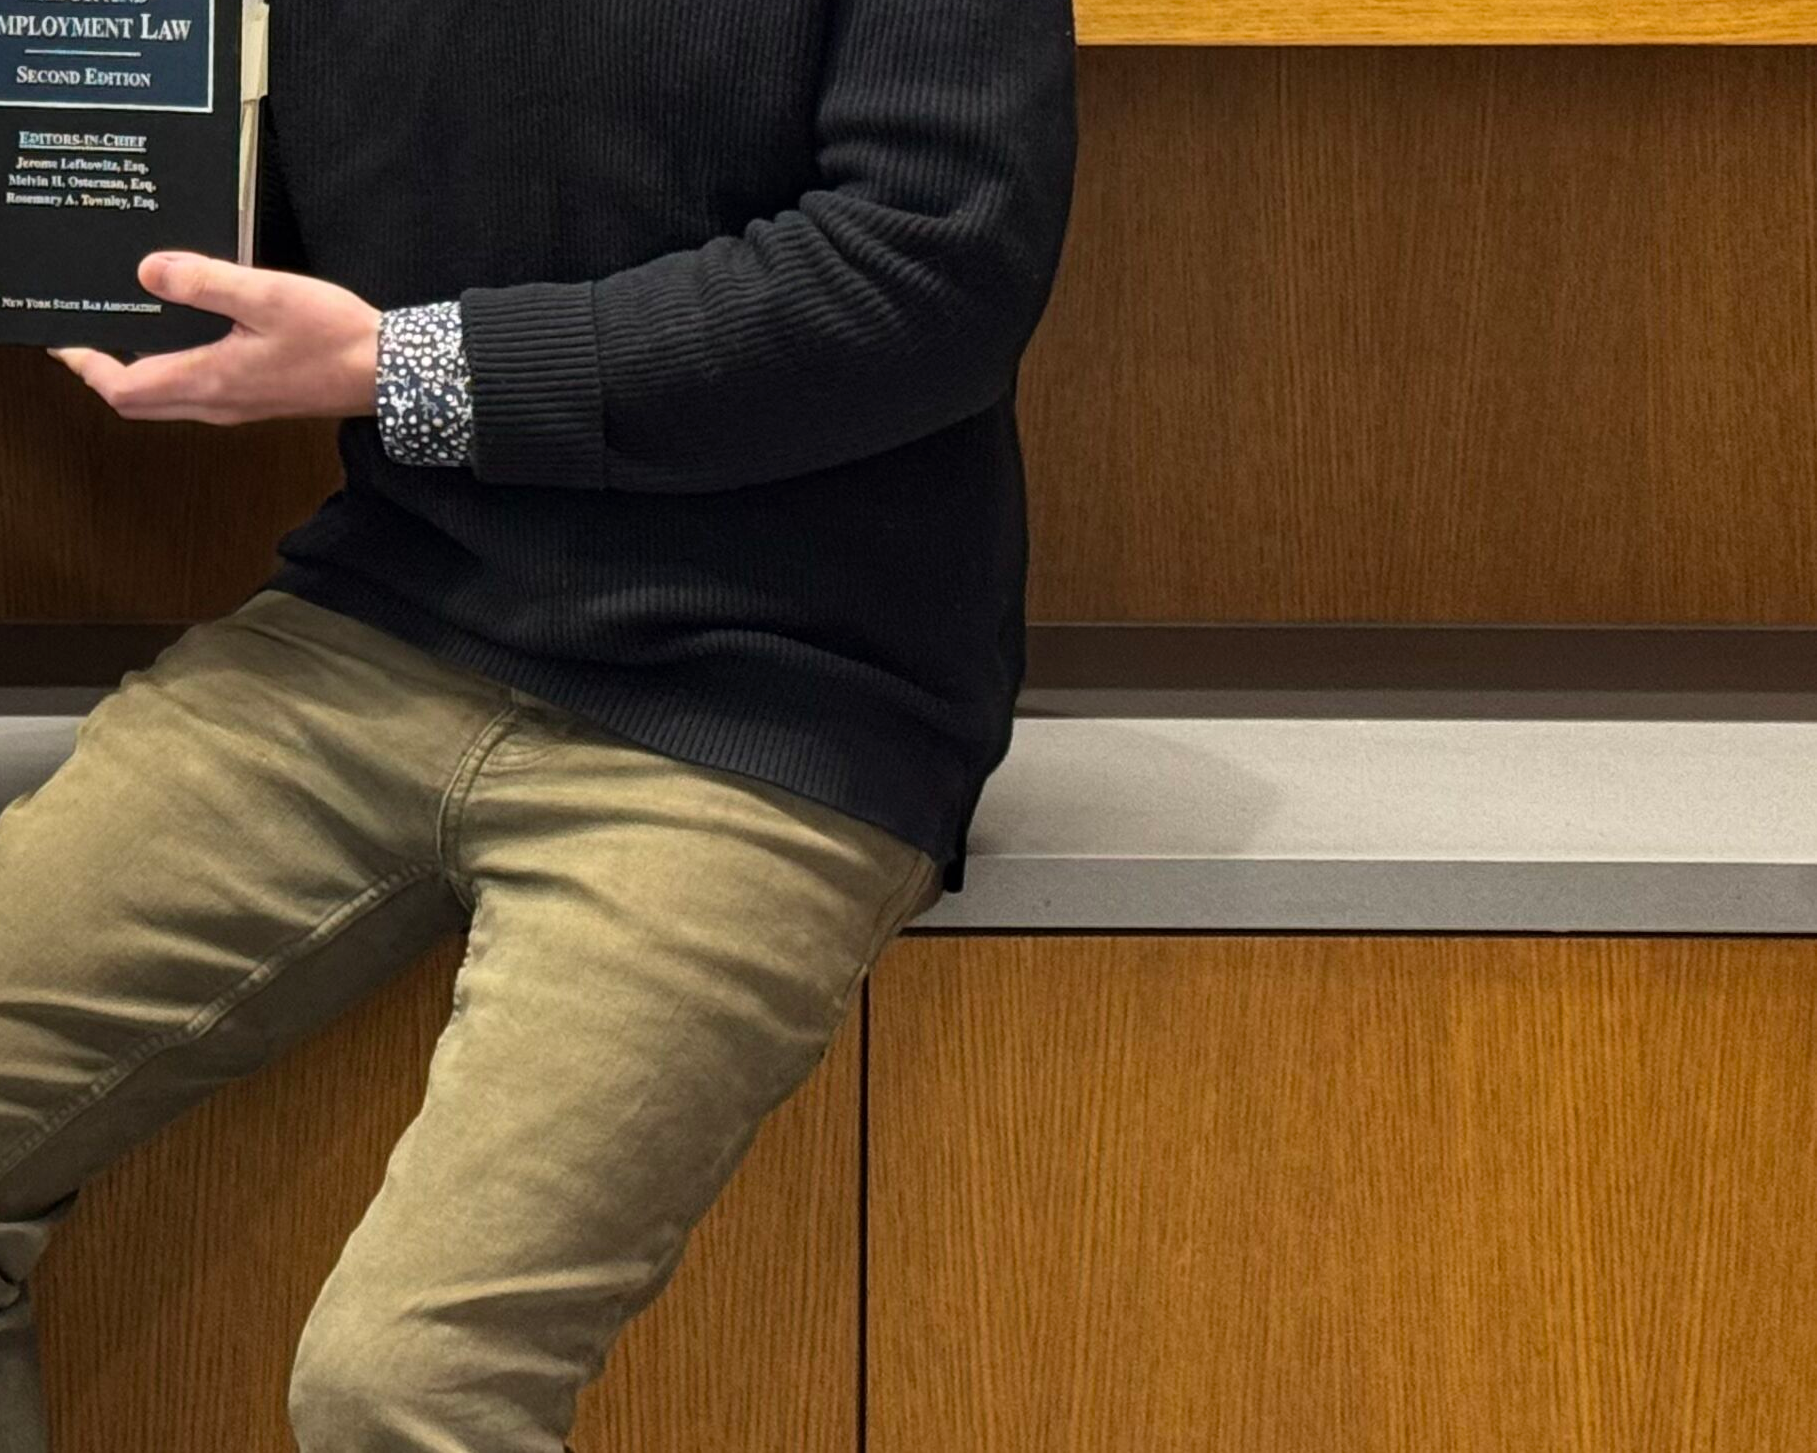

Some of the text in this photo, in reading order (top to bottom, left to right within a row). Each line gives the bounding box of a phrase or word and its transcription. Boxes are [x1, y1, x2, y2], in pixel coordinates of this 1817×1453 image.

[139, 13, 192, 41] LAW
[16, 65, 151, 87] SECOND EDITION
[19, 131, 147, 148] EDITORS-IN-CHIEF
[15, 156, 149, 174] Jerome Lefkowitz, Esq.
[8, 174, 48, 187] Melvin
[68, 177, 128, 191] Osterman,
[130, 178, 156, 193] Esq.
[6, 192, 158, 211] Rosemary A. Townley, Esq.
[1, 297, 24, 308] NEW
[26, 298, 51, 309] YORK
[53, 299, 80, 310] STATE
[103, 301, 162, 313] ASSOCIATION
